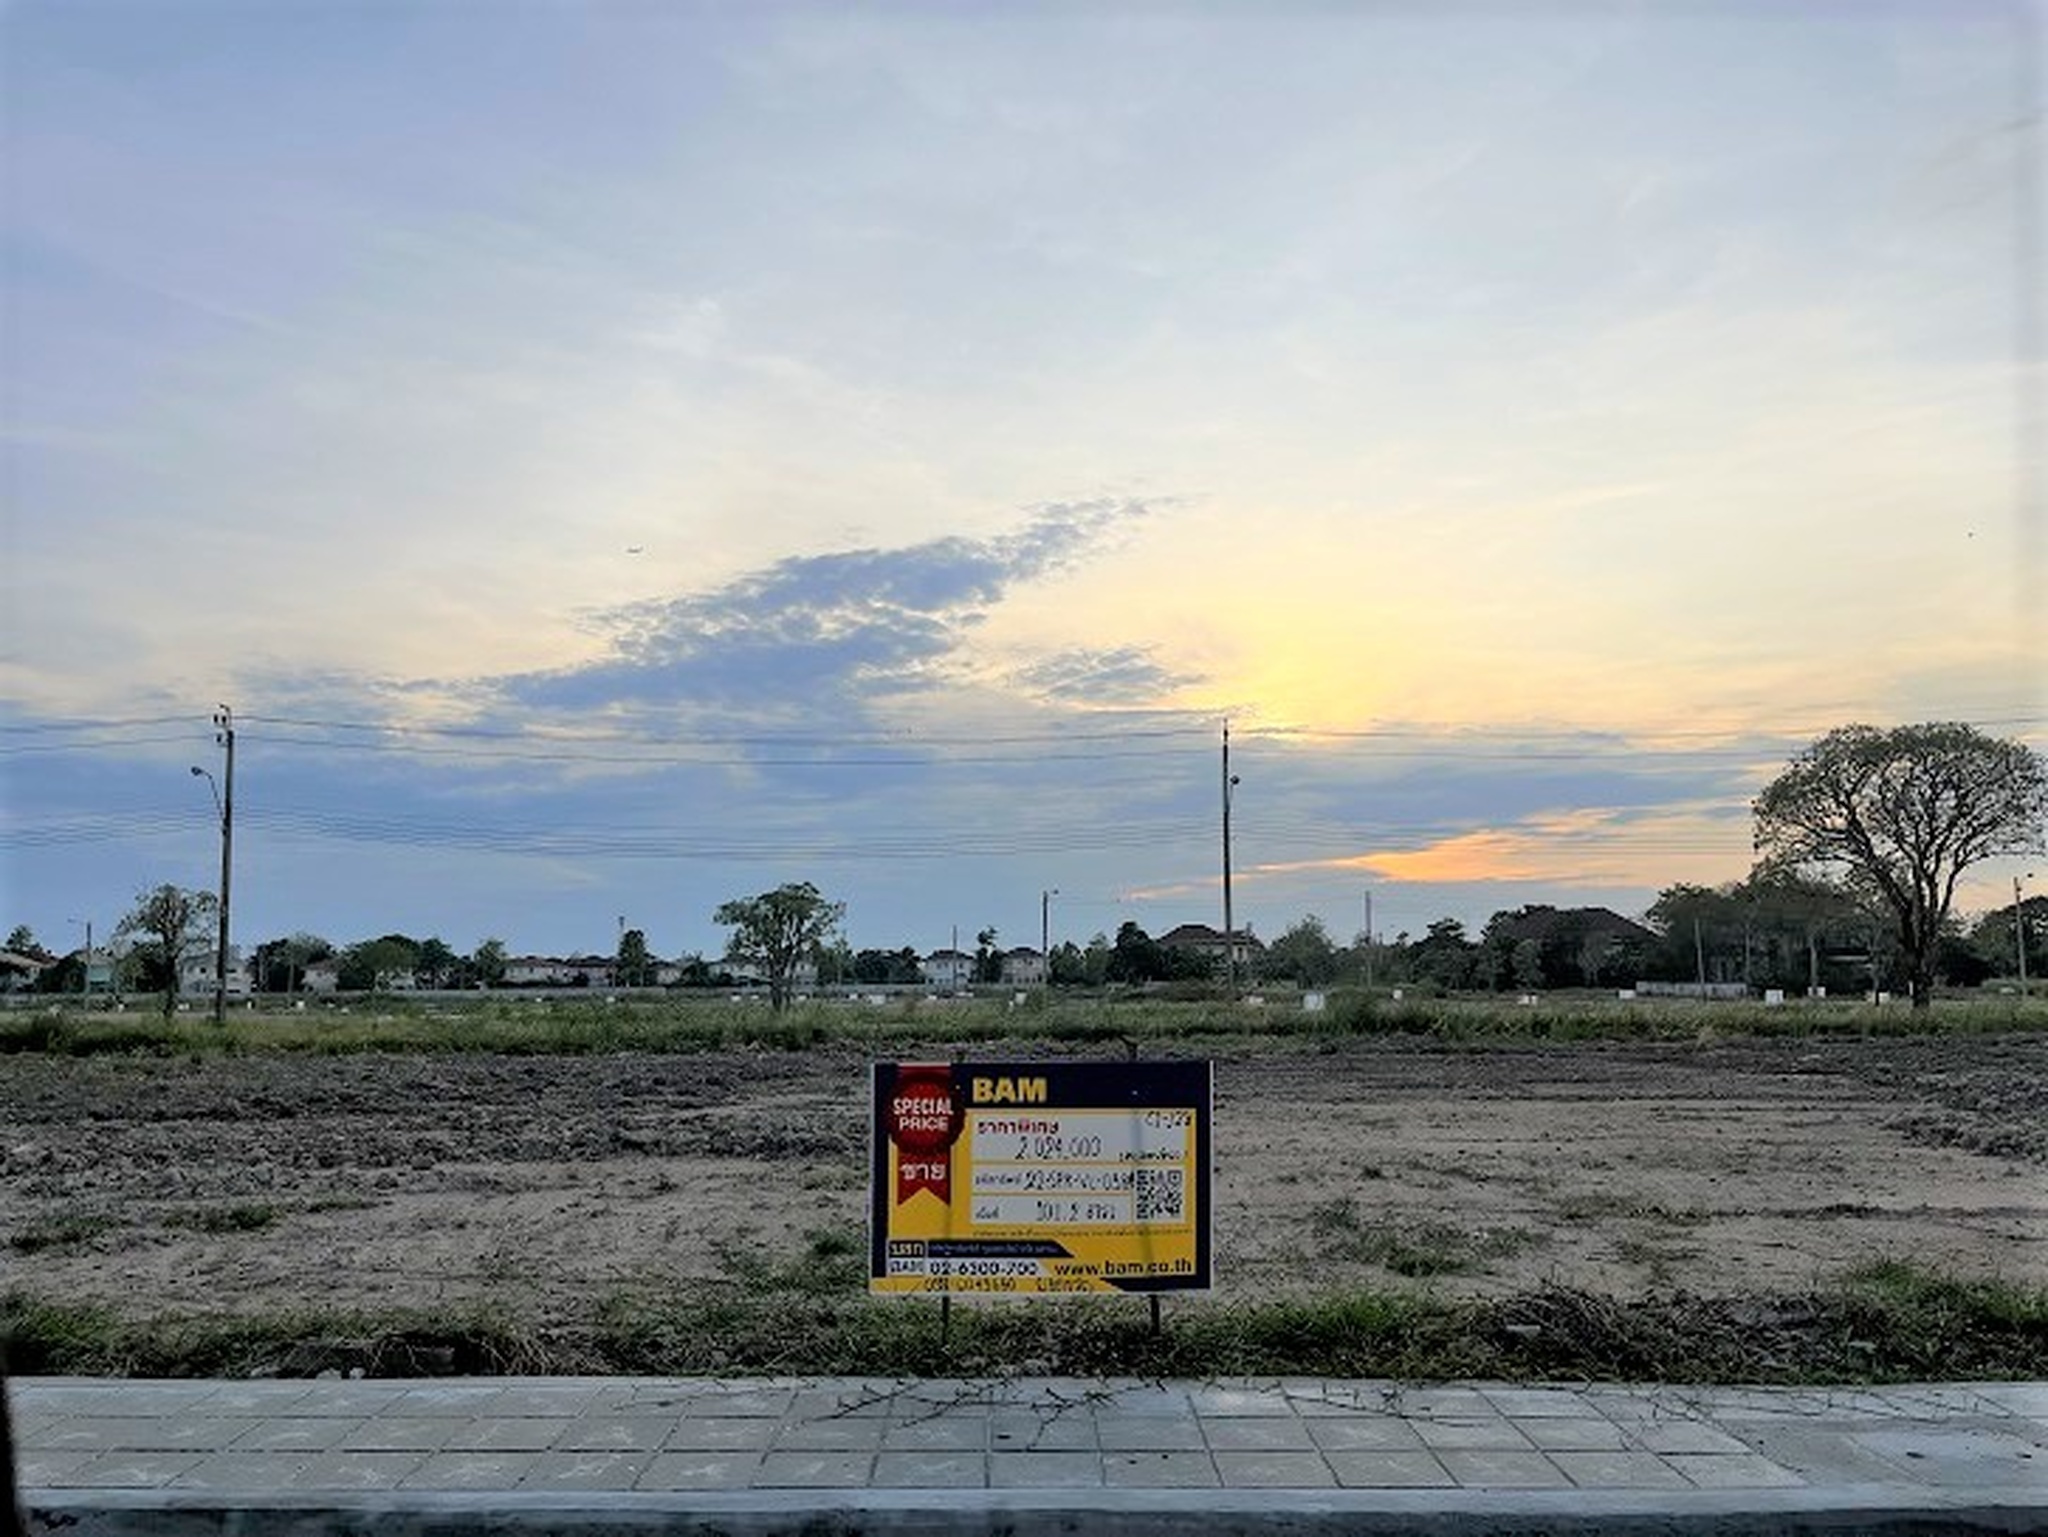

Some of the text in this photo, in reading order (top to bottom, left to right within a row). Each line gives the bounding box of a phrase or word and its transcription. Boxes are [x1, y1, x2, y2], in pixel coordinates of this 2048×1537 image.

[972, 1077, 1048, 1103] BAM
[893, 1096, 954, 1116] SPECIAL
[899, 1115, 949, 1132] PRICE
[900, 1162, 947, 1182] ขาย
[1053, 1256, 1192, 1277] www.bam.co.th
